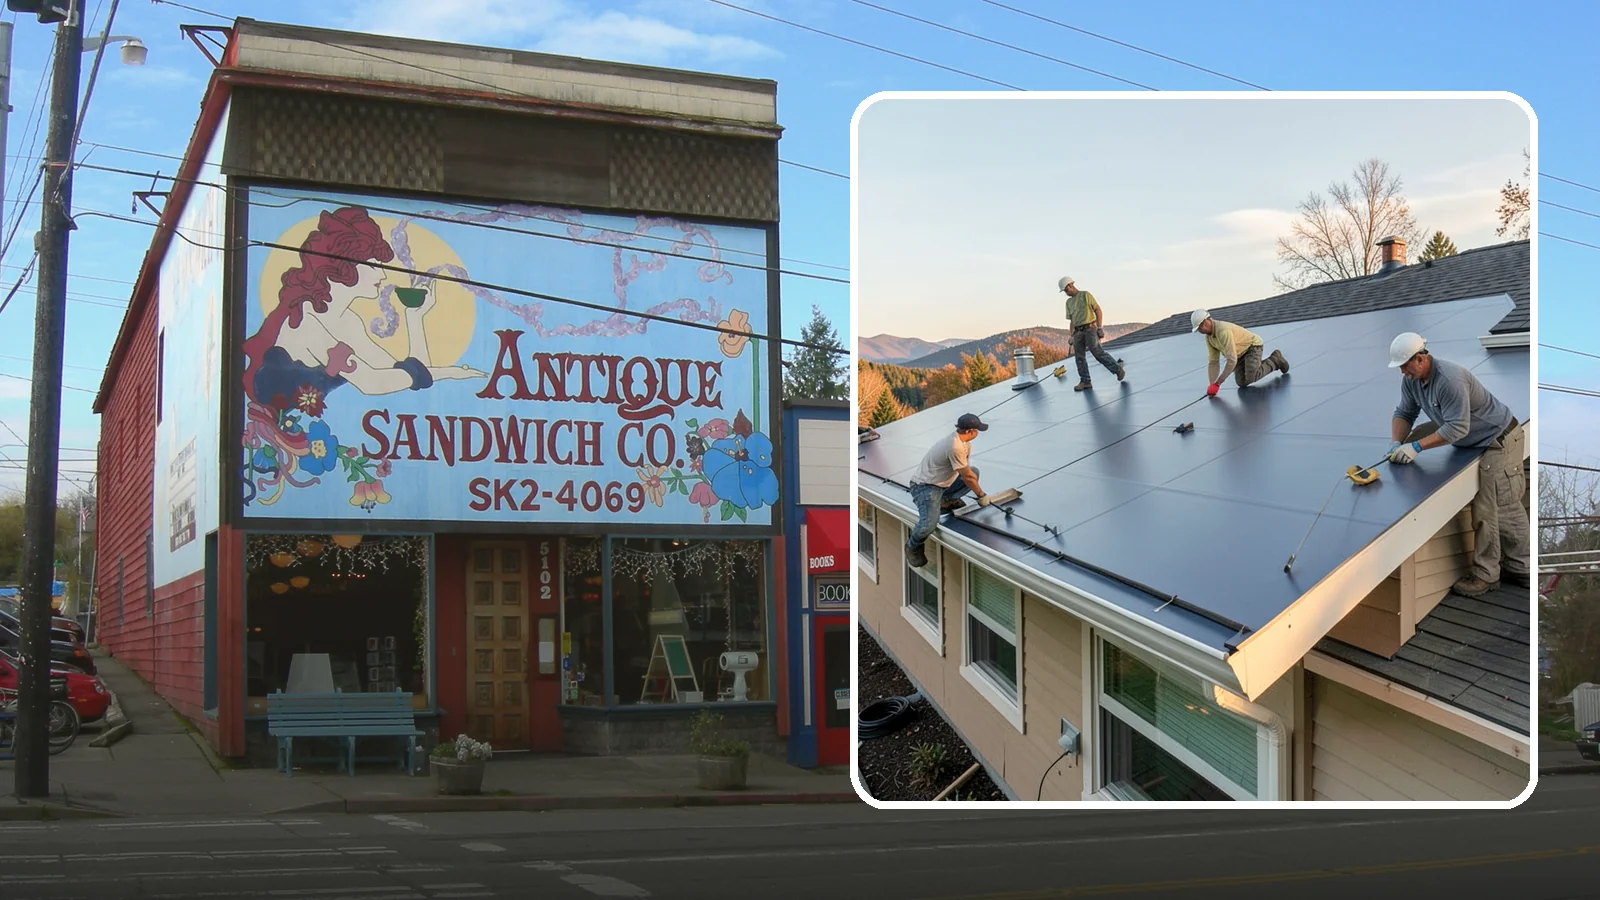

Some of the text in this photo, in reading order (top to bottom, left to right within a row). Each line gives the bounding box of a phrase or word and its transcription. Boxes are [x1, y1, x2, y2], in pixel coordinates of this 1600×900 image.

[476, 329, 723, 420] ANTIQUE
[361, 409, 685, 468] SANDWICH CO.
[468, 477, 645, 513] SK2-4069
[540, 542, 551, 599] 5102
[810, 555, 834, 568] BOOKS
